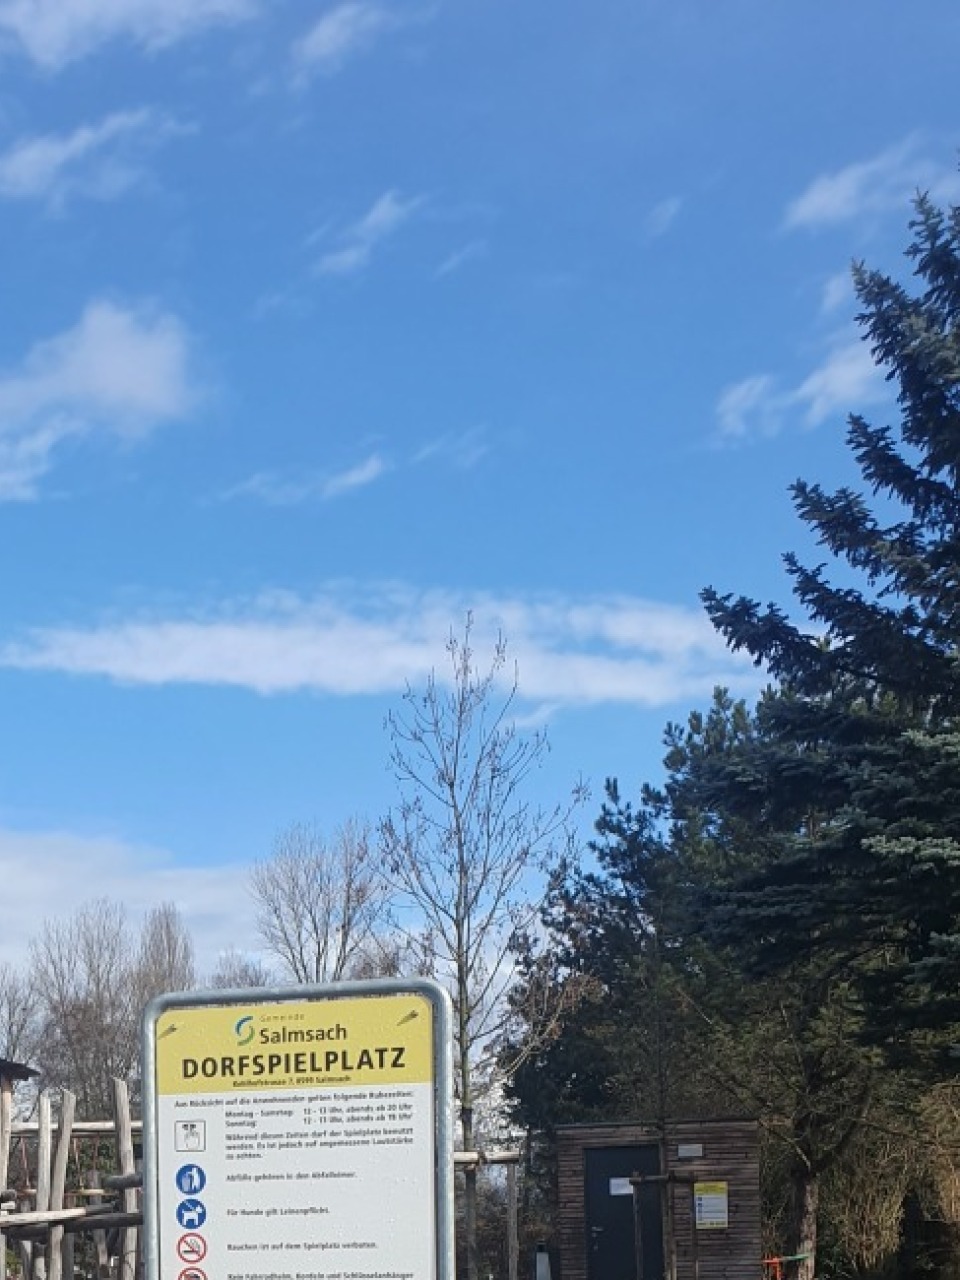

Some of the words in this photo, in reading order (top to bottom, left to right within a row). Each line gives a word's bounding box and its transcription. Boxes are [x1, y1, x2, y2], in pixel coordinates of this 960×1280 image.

[260, 1024, 348, 1044] Salmsach
[182, 1047, 406, 1079] DORFSPIELPLATZ
[225, 1110, 254, 1119] Montag
[304, 1242, 340, 1251] Spielplatz
